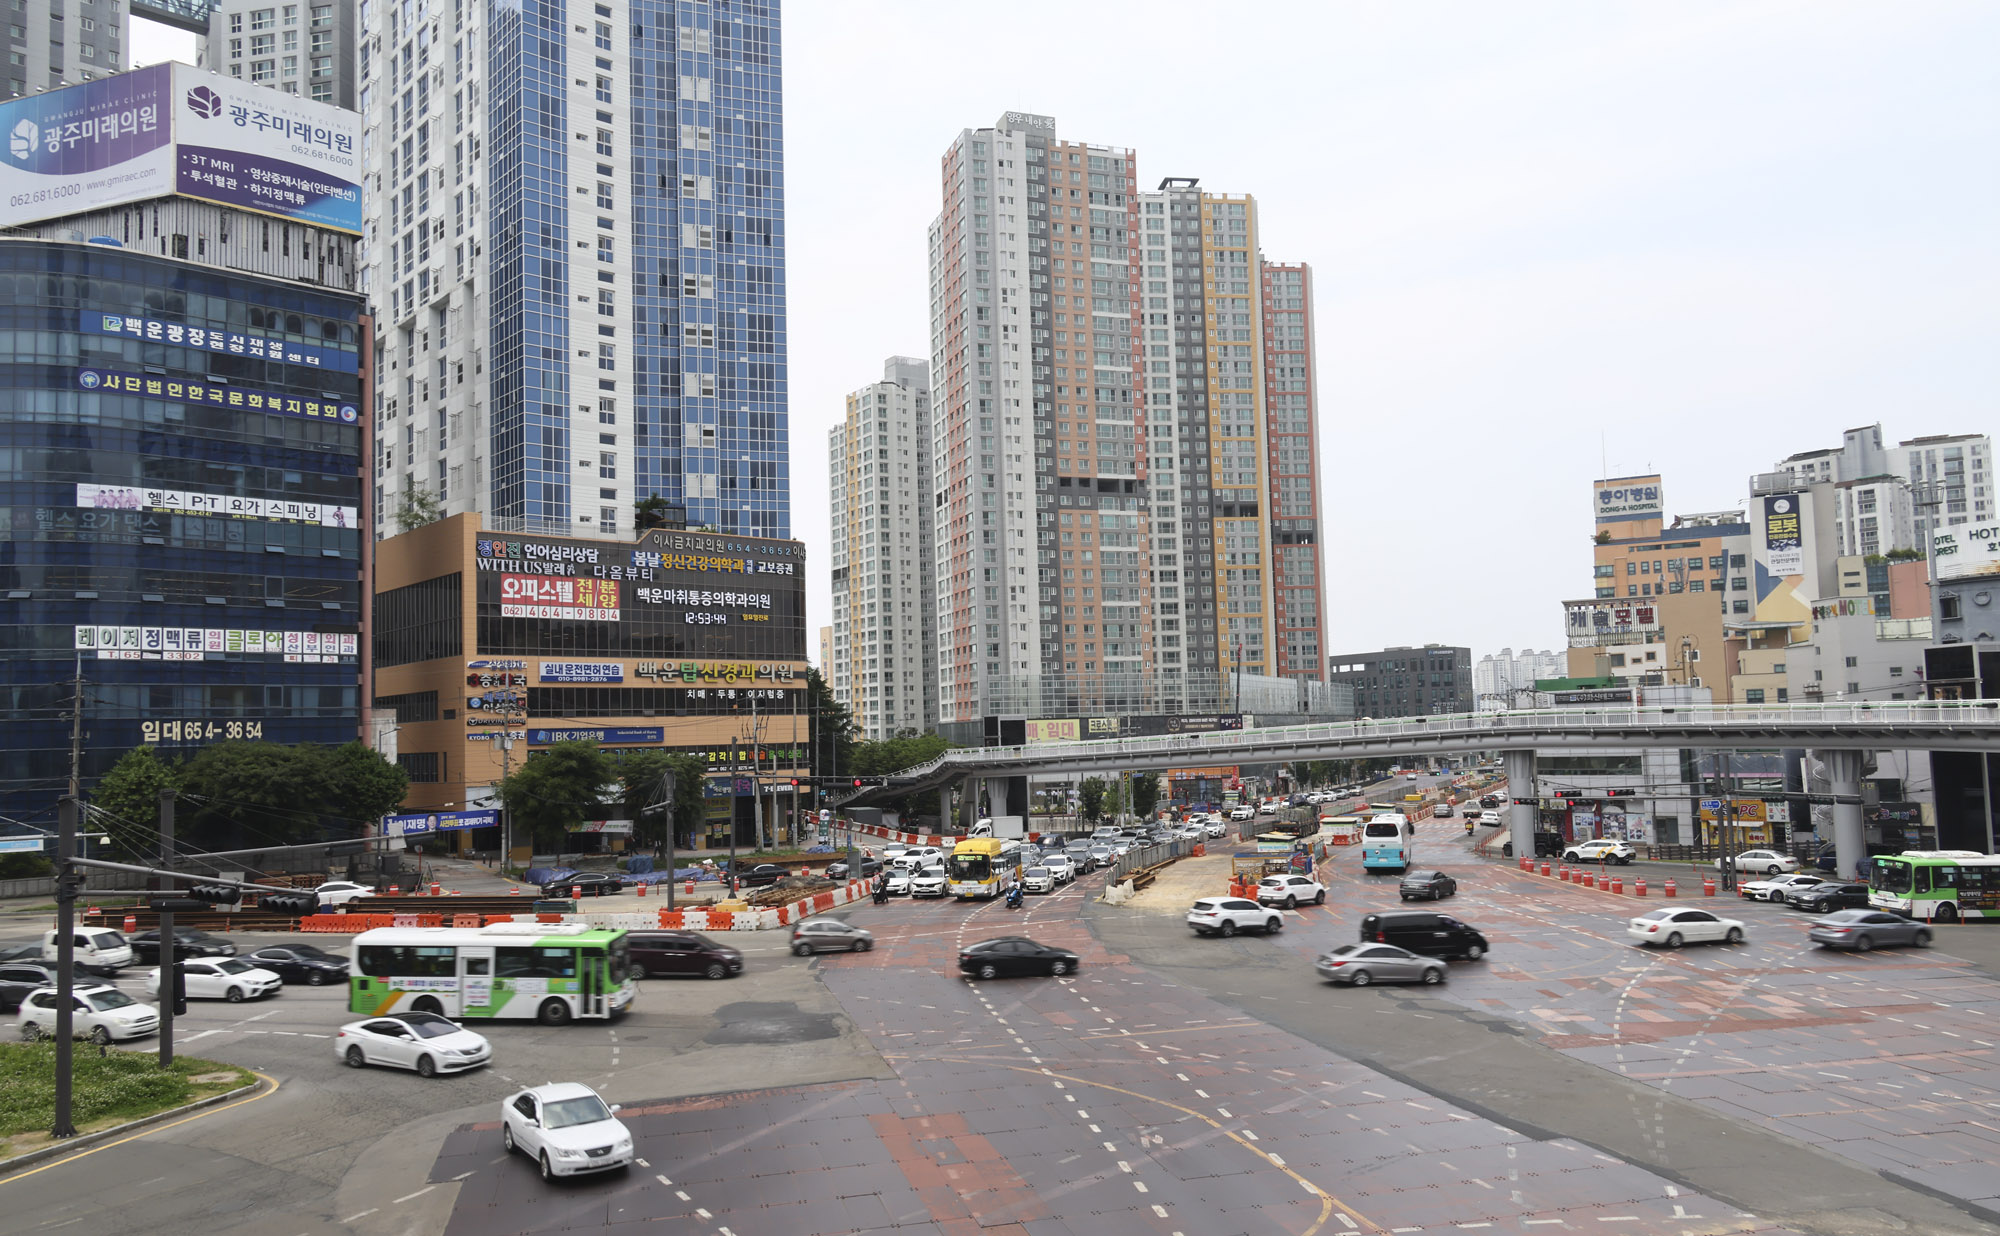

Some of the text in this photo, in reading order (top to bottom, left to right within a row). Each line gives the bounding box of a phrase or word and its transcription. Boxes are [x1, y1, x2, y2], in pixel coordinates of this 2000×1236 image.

[90, 101, 119, 113] MIRAE
[124, 90, 157, 104] CLINIC
[44, 103, 157, 153] 광주미래의원
[229, 104, 353, 155] 광주미래의원
[282, 107, 313, 121] MIRAE
[318, 119, 353, 132] CLINIC
[191, 154, 235, 173] 3T MRI
[291, 144, 354, 167] 062.681.6000
[10, 183, 81, 207] 062.681.6000
[86, 168, 157, 191] www.gmiraec.com
[190, 170, 238, 190] 투석혈관
[250, 167, 356, 202] 영상중재시술(인터벤션)
[250, 184, 306, 205] 하지정맥류
[125, 317, 283, 351] 백운광장 도시재생
[209, 341, 320, 365] 현장지원센터
[103, 374, 338, 419] 사단법인한국문화복지협회
[147, 491, 180, 506] 헬스
[230, 499, 260, 514] 요가
[269, 503, 317, 519] 스피닝
[1599, 486, 1658, 504] 동아병원
[1600, 503, 1658, 513] DONG-A HOSPITAL
[79, 512, 118, 532] 요가
[1768, 519, 1798, 533] 로봇
[654, 534, 725, 553] 이사금치과의원
[727, 543, 791, 556] 654-3652
[1934, 534, 1956, 545] OTEL
[524, 543, 599, 564] 언어심리상담
[633, 551, 660, 568] 봄날
[660, 553, 745, 573] 정신건강의학과
[757, 562, 793, 575] 교보증권
[477, 558, 565, 576] WITH US 발레
[502, 578, 574, 603] 오피스텔
[637, 588, 771, 609] 백운마취통증의학과의원
[685, 613, 727, 625] 12:53:44
[1839, 600, 1876, 616] MOTEL
[78, 627, 140, 647] 레이저
[145, 629, 203, 650] 정맥류
[227, 630, 283, 652] 클로아
[638, 661, 794, 683] 백운탑신경과의원
[687, 689, 706, 699] 치매
[717, 690, 736, 699] 두통
[141, 720, 262, 742] 임대 654-3654
[552, 731, 605, 742] IBK 기업은행
[1739, 804, 1758, 816] PC
